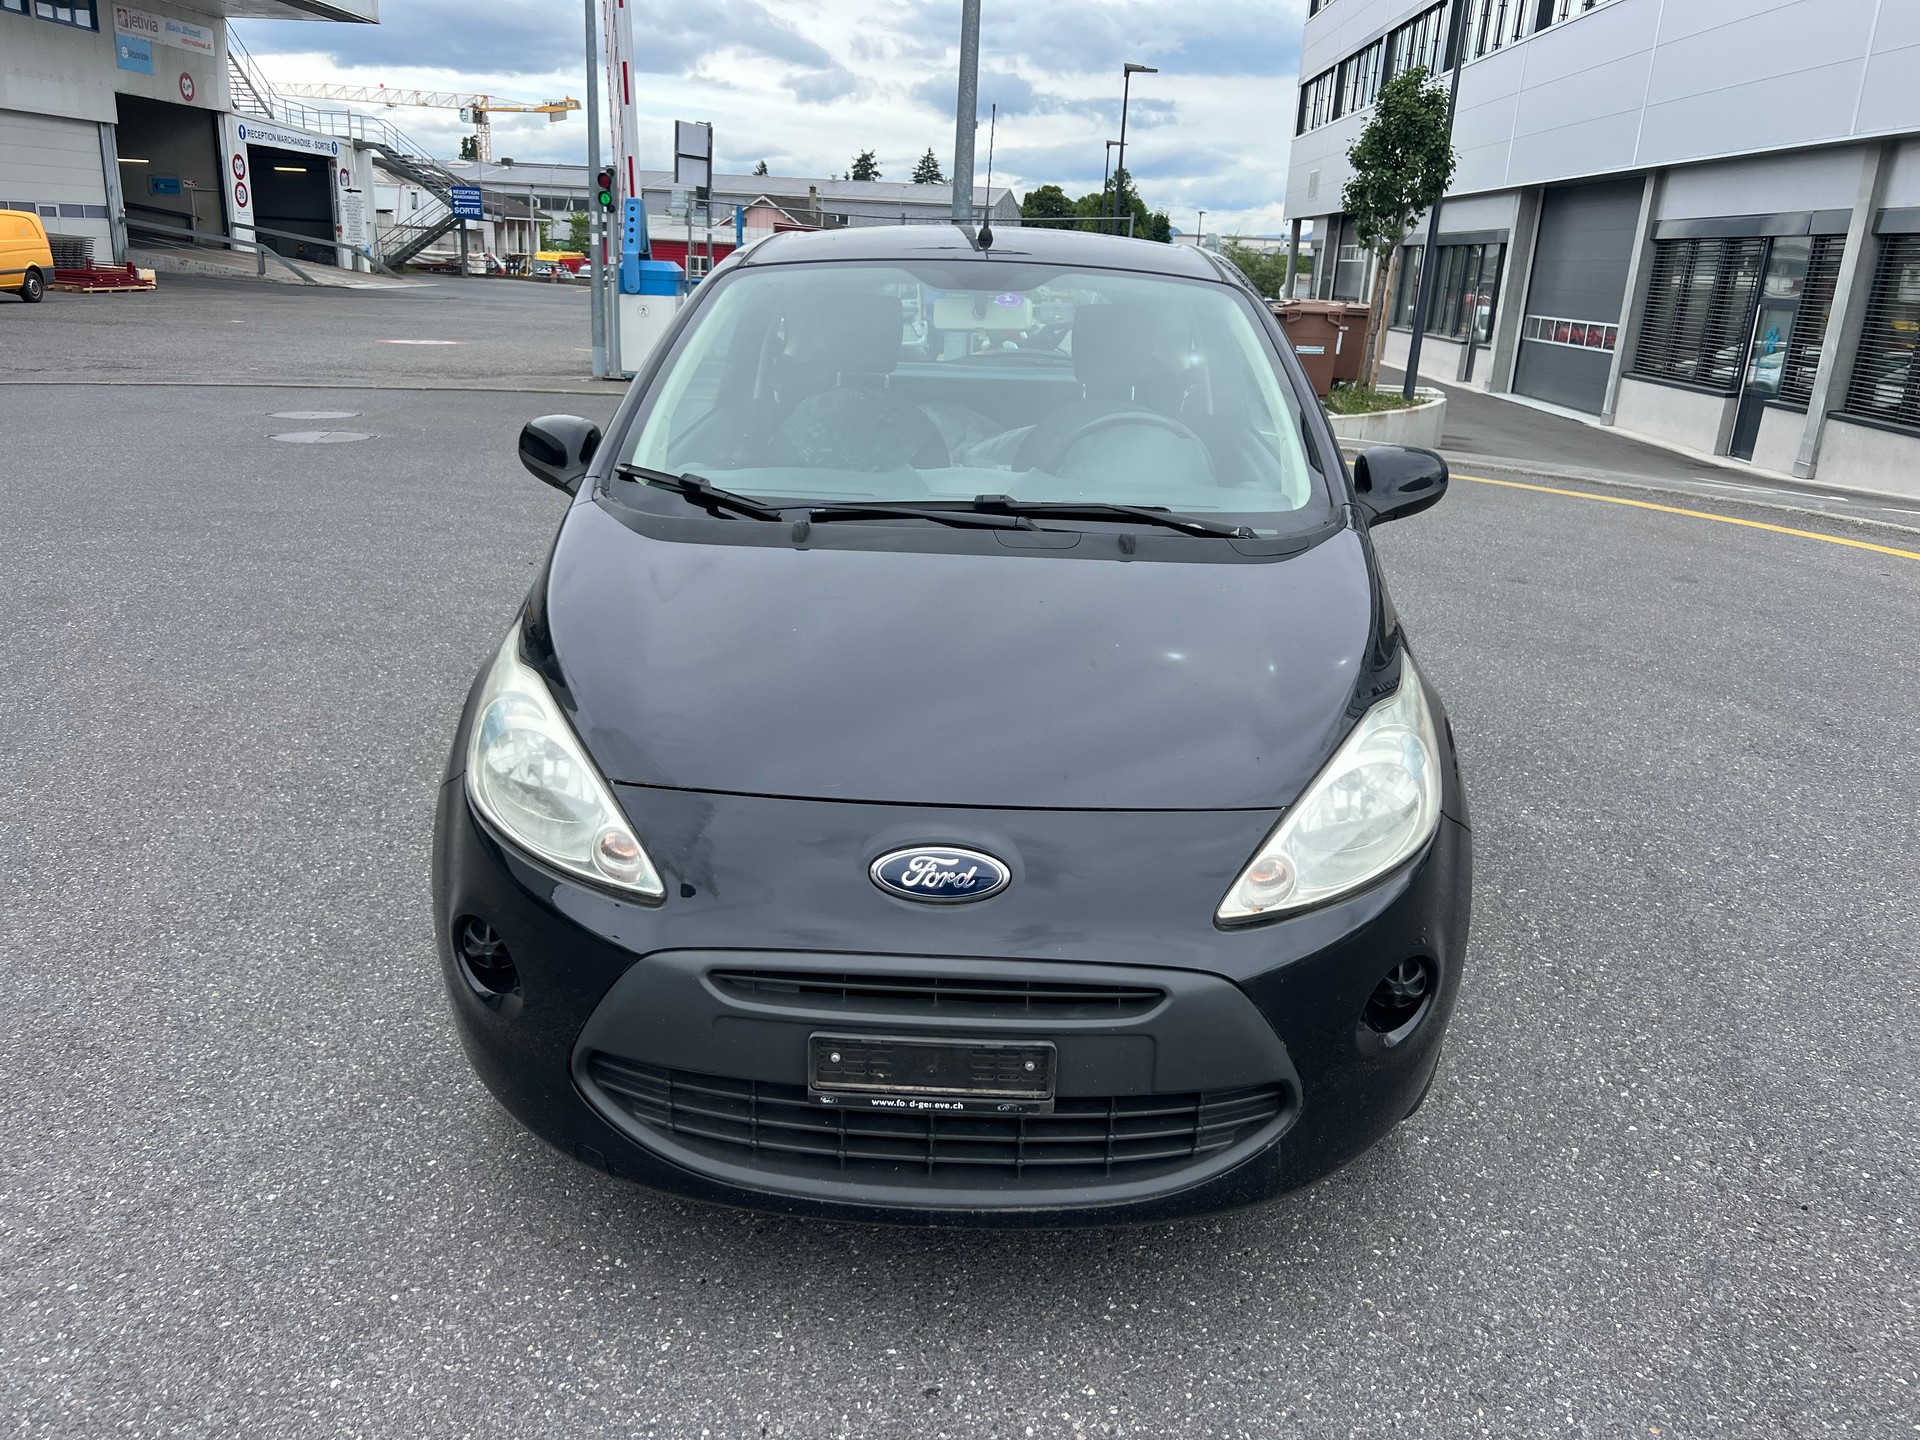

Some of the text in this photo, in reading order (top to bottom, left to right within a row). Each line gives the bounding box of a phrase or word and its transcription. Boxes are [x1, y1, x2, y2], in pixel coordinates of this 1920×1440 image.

[128, 10, 159, 32] jetivia
[247, 129, 277, 141] RECEPTION
[277, 133, 311, 148] MARCHANDISE
[315, 141, 331, 151] SORTIE
[238, 189, 245, 200] 30
[454, 207, 481, 215] SORTIE
[901, 855, 978, 889] Ford
[871, 1099, 964, 1110] www.fod-geeve.ch
